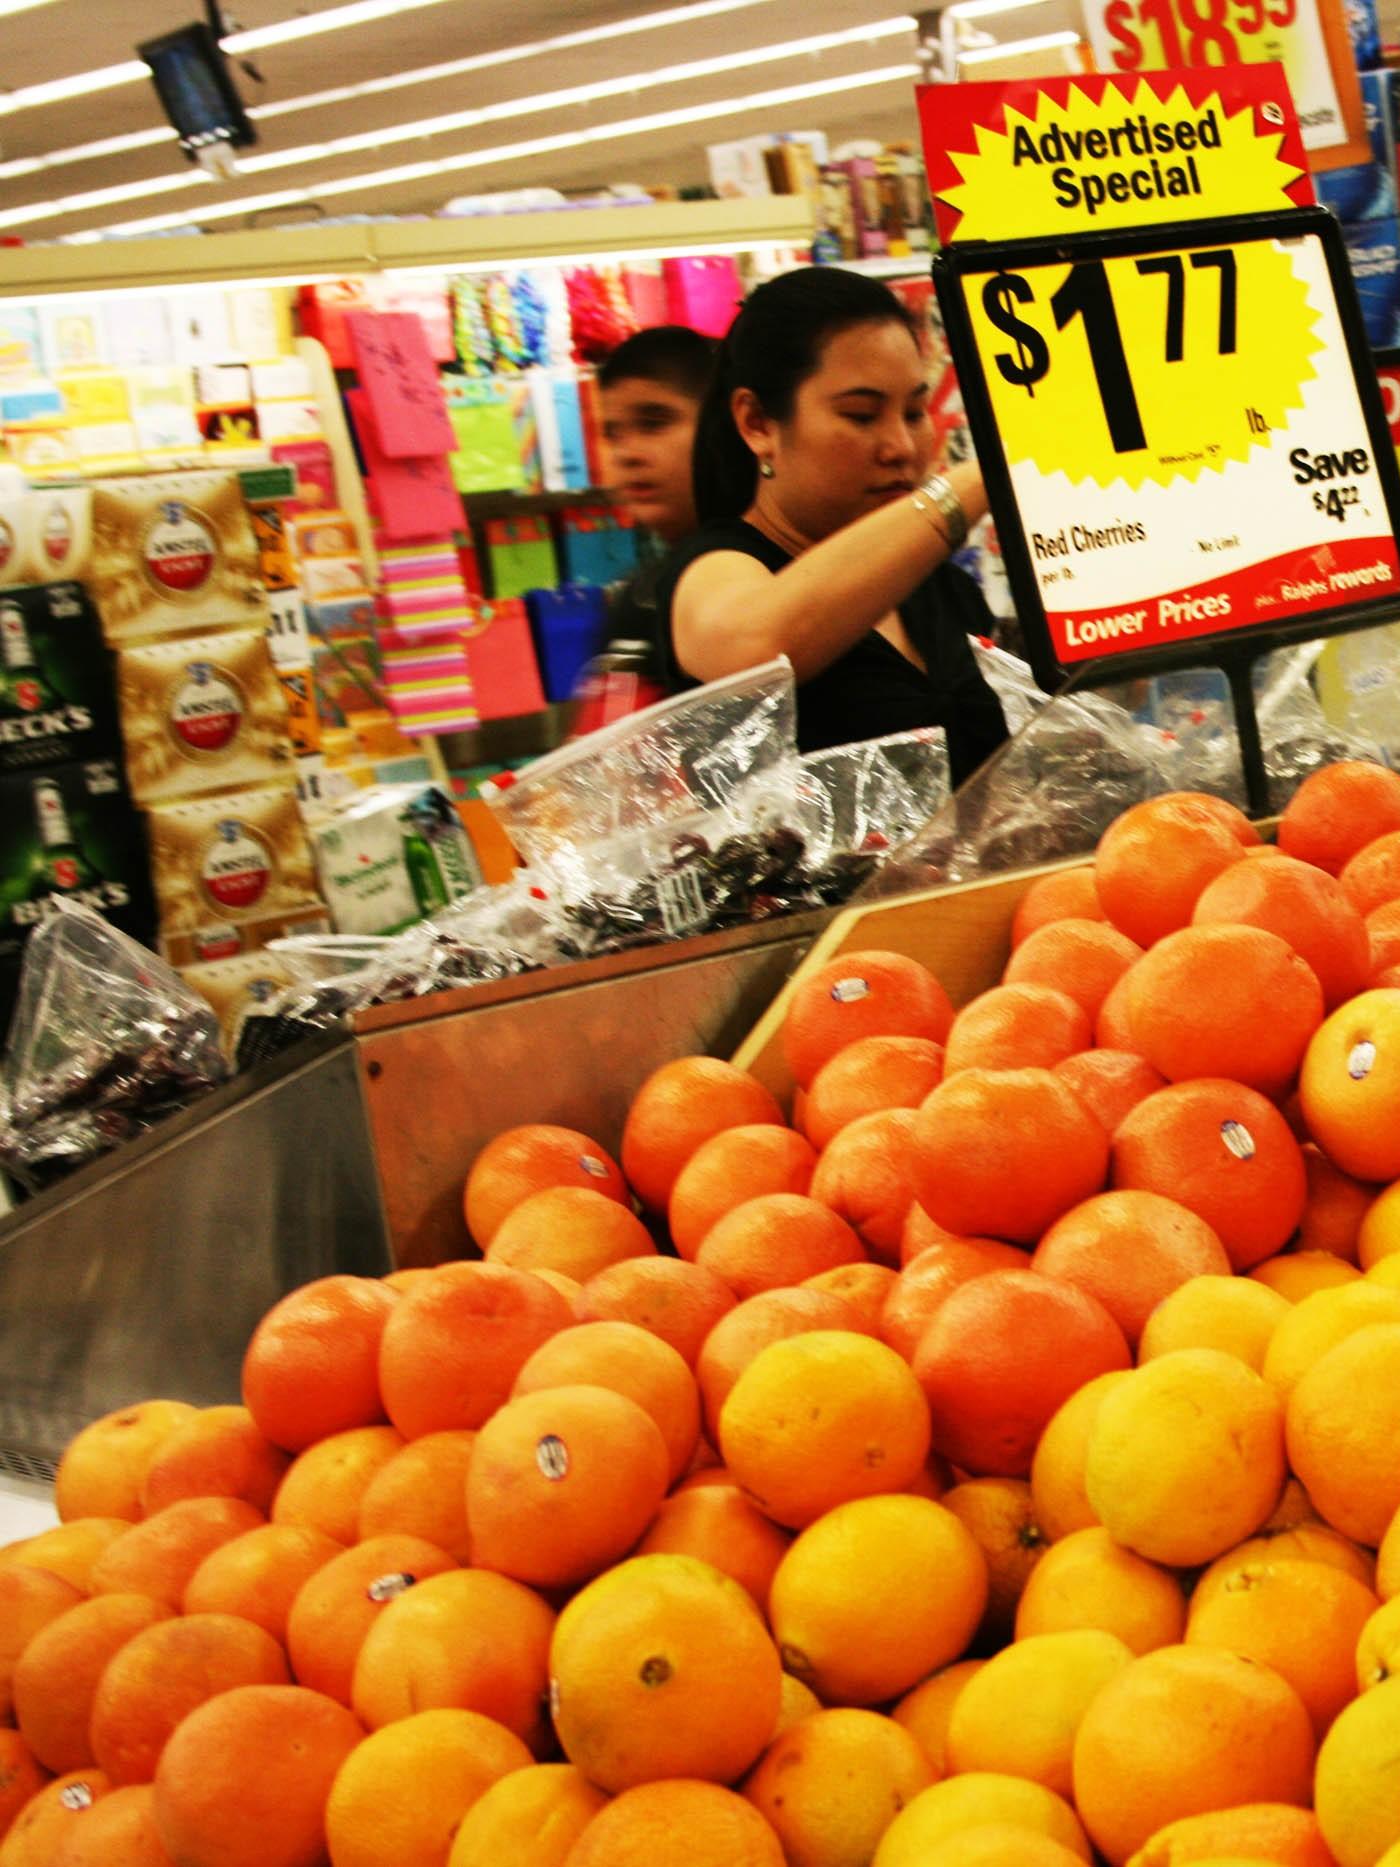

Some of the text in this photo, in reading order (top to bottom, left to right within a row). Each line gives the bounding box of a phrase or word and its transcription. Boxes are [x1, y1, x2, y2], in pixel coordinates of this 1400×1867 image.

[1012, 109, 1222, 167] Advertised
[1051, 156, 1202, 214] Special
[1289, 447, 1369, 485] Save
[1031, 517, 1146, 560] Red Cherries
[1065, 610, 1148, 647] Lower
[1157, 593, 1232, 627] Prices
[0, 704, 94, 743] ECK'S
